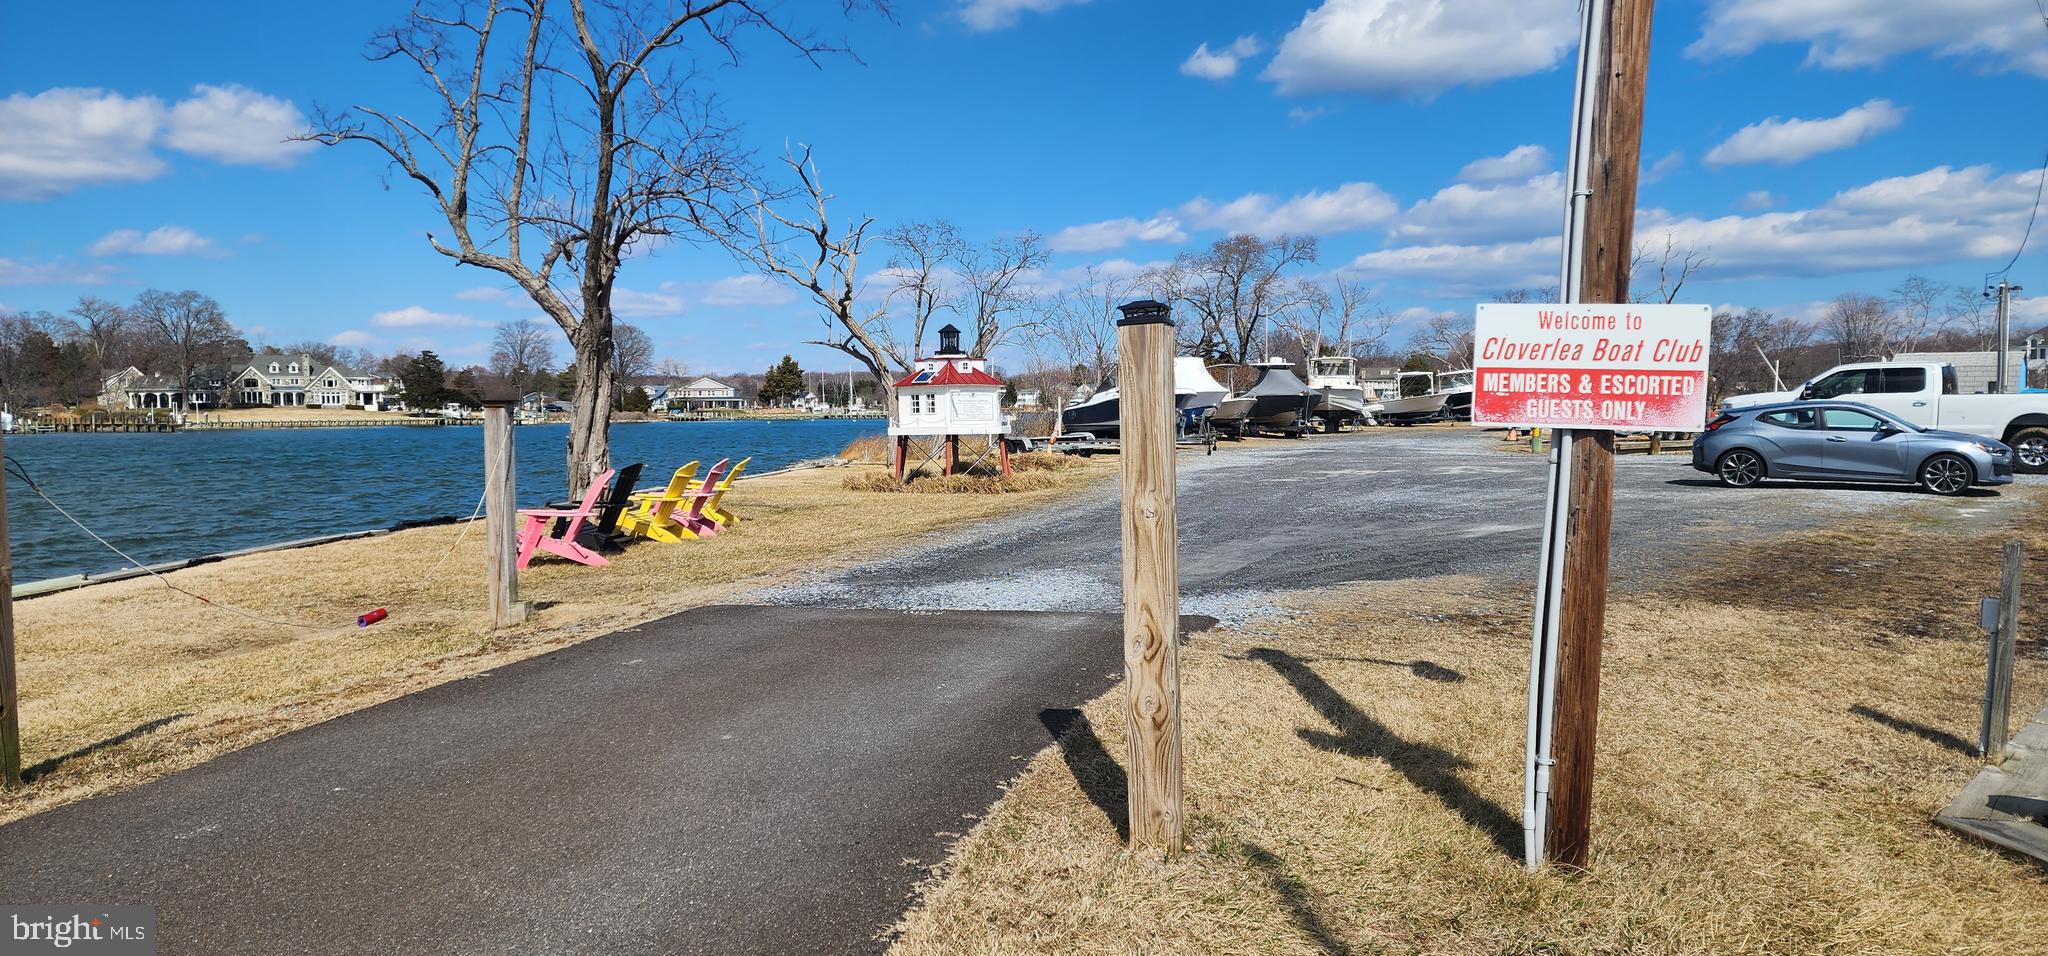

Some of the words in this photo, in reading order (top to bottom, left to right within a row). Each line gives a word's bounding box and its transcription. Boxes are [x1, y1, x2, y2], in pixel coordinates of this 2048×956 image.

[1538, 310, 1616, 330] Welcome
[1626, 312, 1642, 330] to
[1482, 337, 1583, 361] Cloverlea
[1592, 338, 1645, 362] Boat
[1652, 338, 1704, 363] Club
[1483, 373, 1571, 394] MEMBERS
[1578, 375, 1592, 393] &
[1601, 374, 1695, 396] ESCORTED
[1527, 399, 1593, 419] GUESTS
[1601, 401, 1646, 421] ONLY
